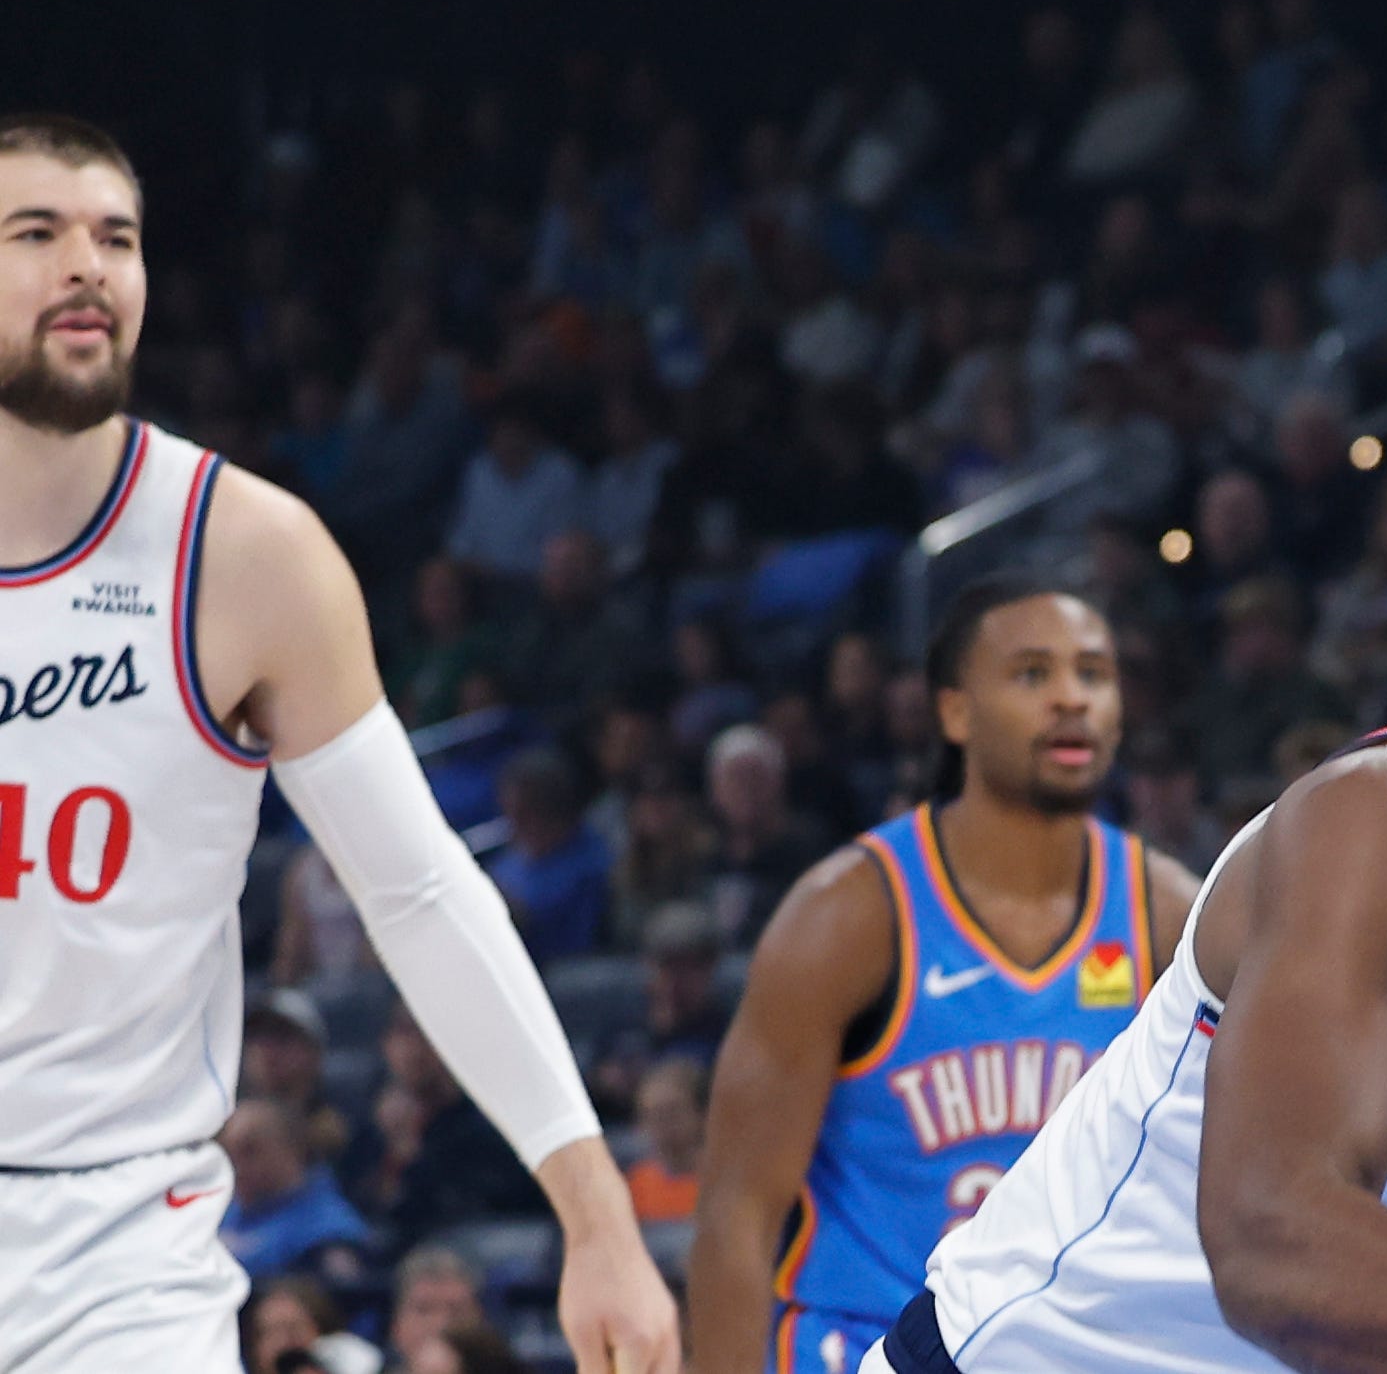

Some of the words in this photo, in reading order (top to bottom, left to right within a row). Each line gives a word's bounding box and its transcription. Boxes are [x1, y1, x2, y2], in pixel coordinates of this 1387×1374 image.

[92, 582, 140, 598] VISIT
[72, 597, 156, 617] RWANDA
[888, 1037, 1106, 1156] THUND
